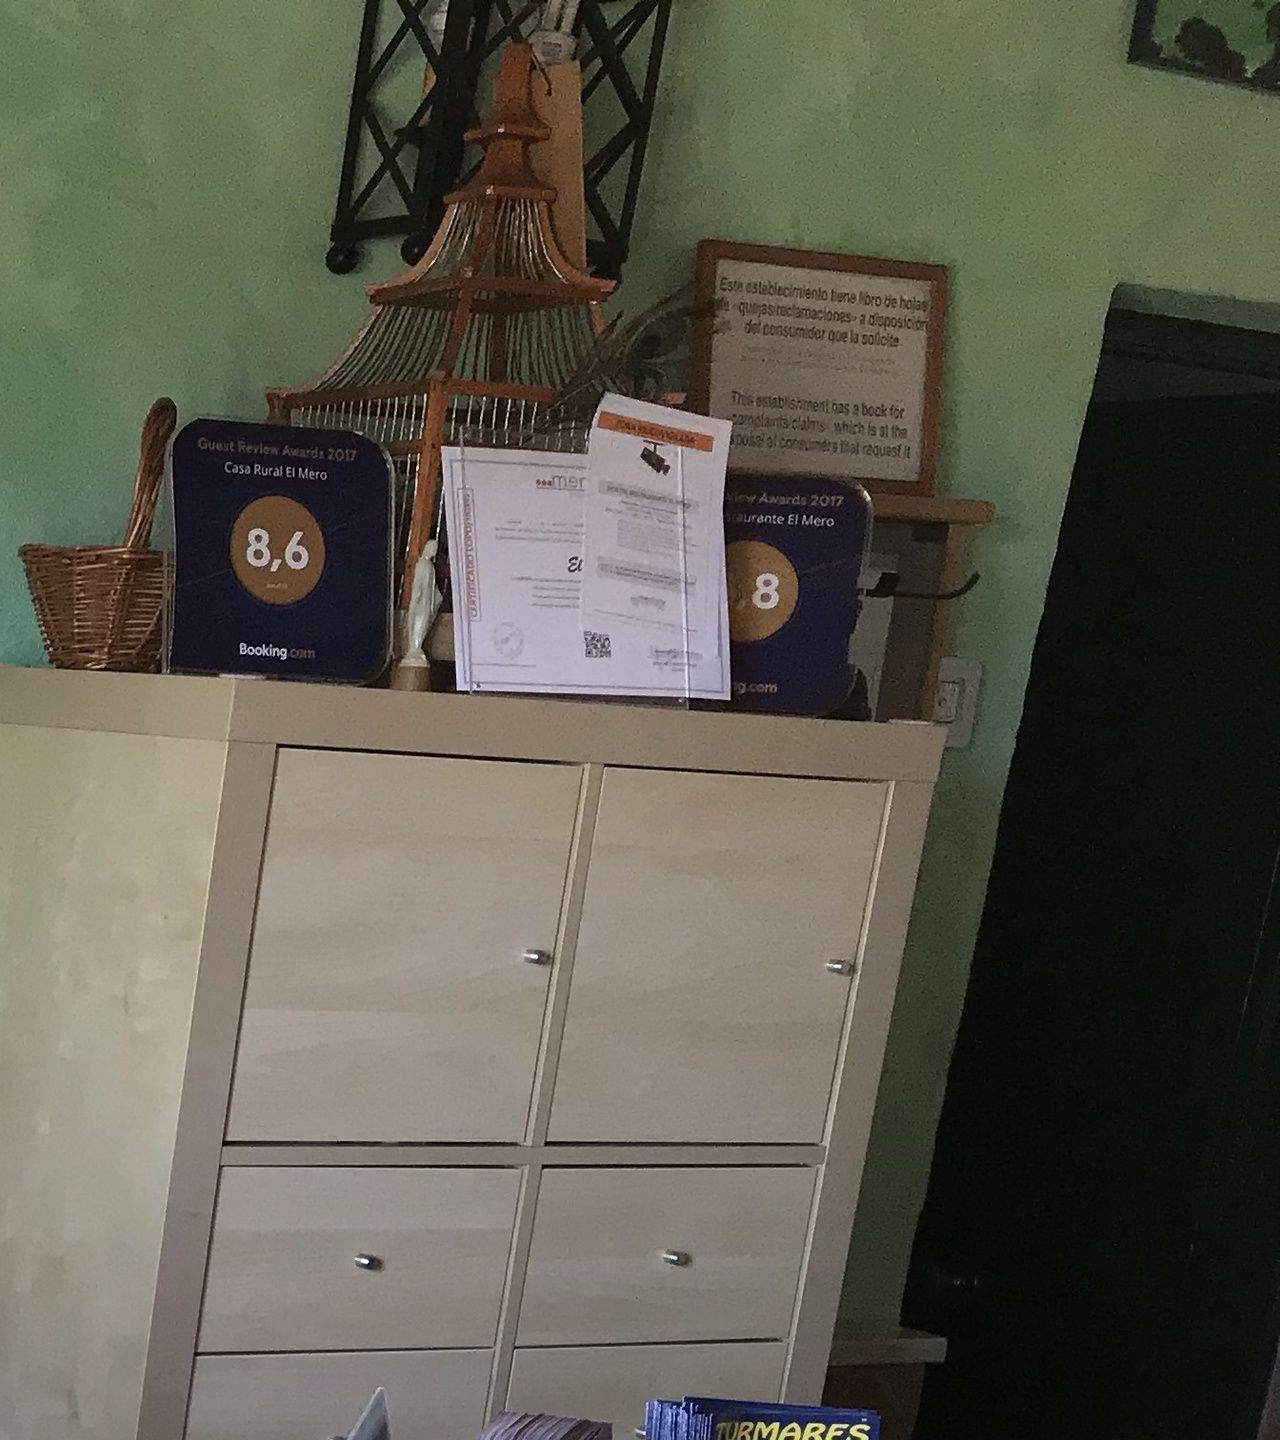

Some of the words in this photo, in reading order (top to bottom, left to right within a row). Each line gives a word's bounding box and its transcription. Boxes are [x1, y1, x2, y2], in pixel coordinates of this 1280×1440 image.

[198, 437, 235, 452] Guest
[238, 440, 279, 456] Review
[282, 446, 325, 459] Awards
[328, 449, 356, 461] 2017
[224, 462, 250, 475] Casa
[254, 464, 282, 477] Rural
[286, 466, 295, 477] El
[298, 467, 327, 480] Mero
[759, 493, 806, 506] Awards
[811, 495, 844, 507] 2017
[787, 513, 798, 525] El
[802, 514, 835, 527] Mero
[246, 528, 309, 572] 8,6
[752, 573, 779, 609] 8
[240, 643, 315, 660] Booking.com
